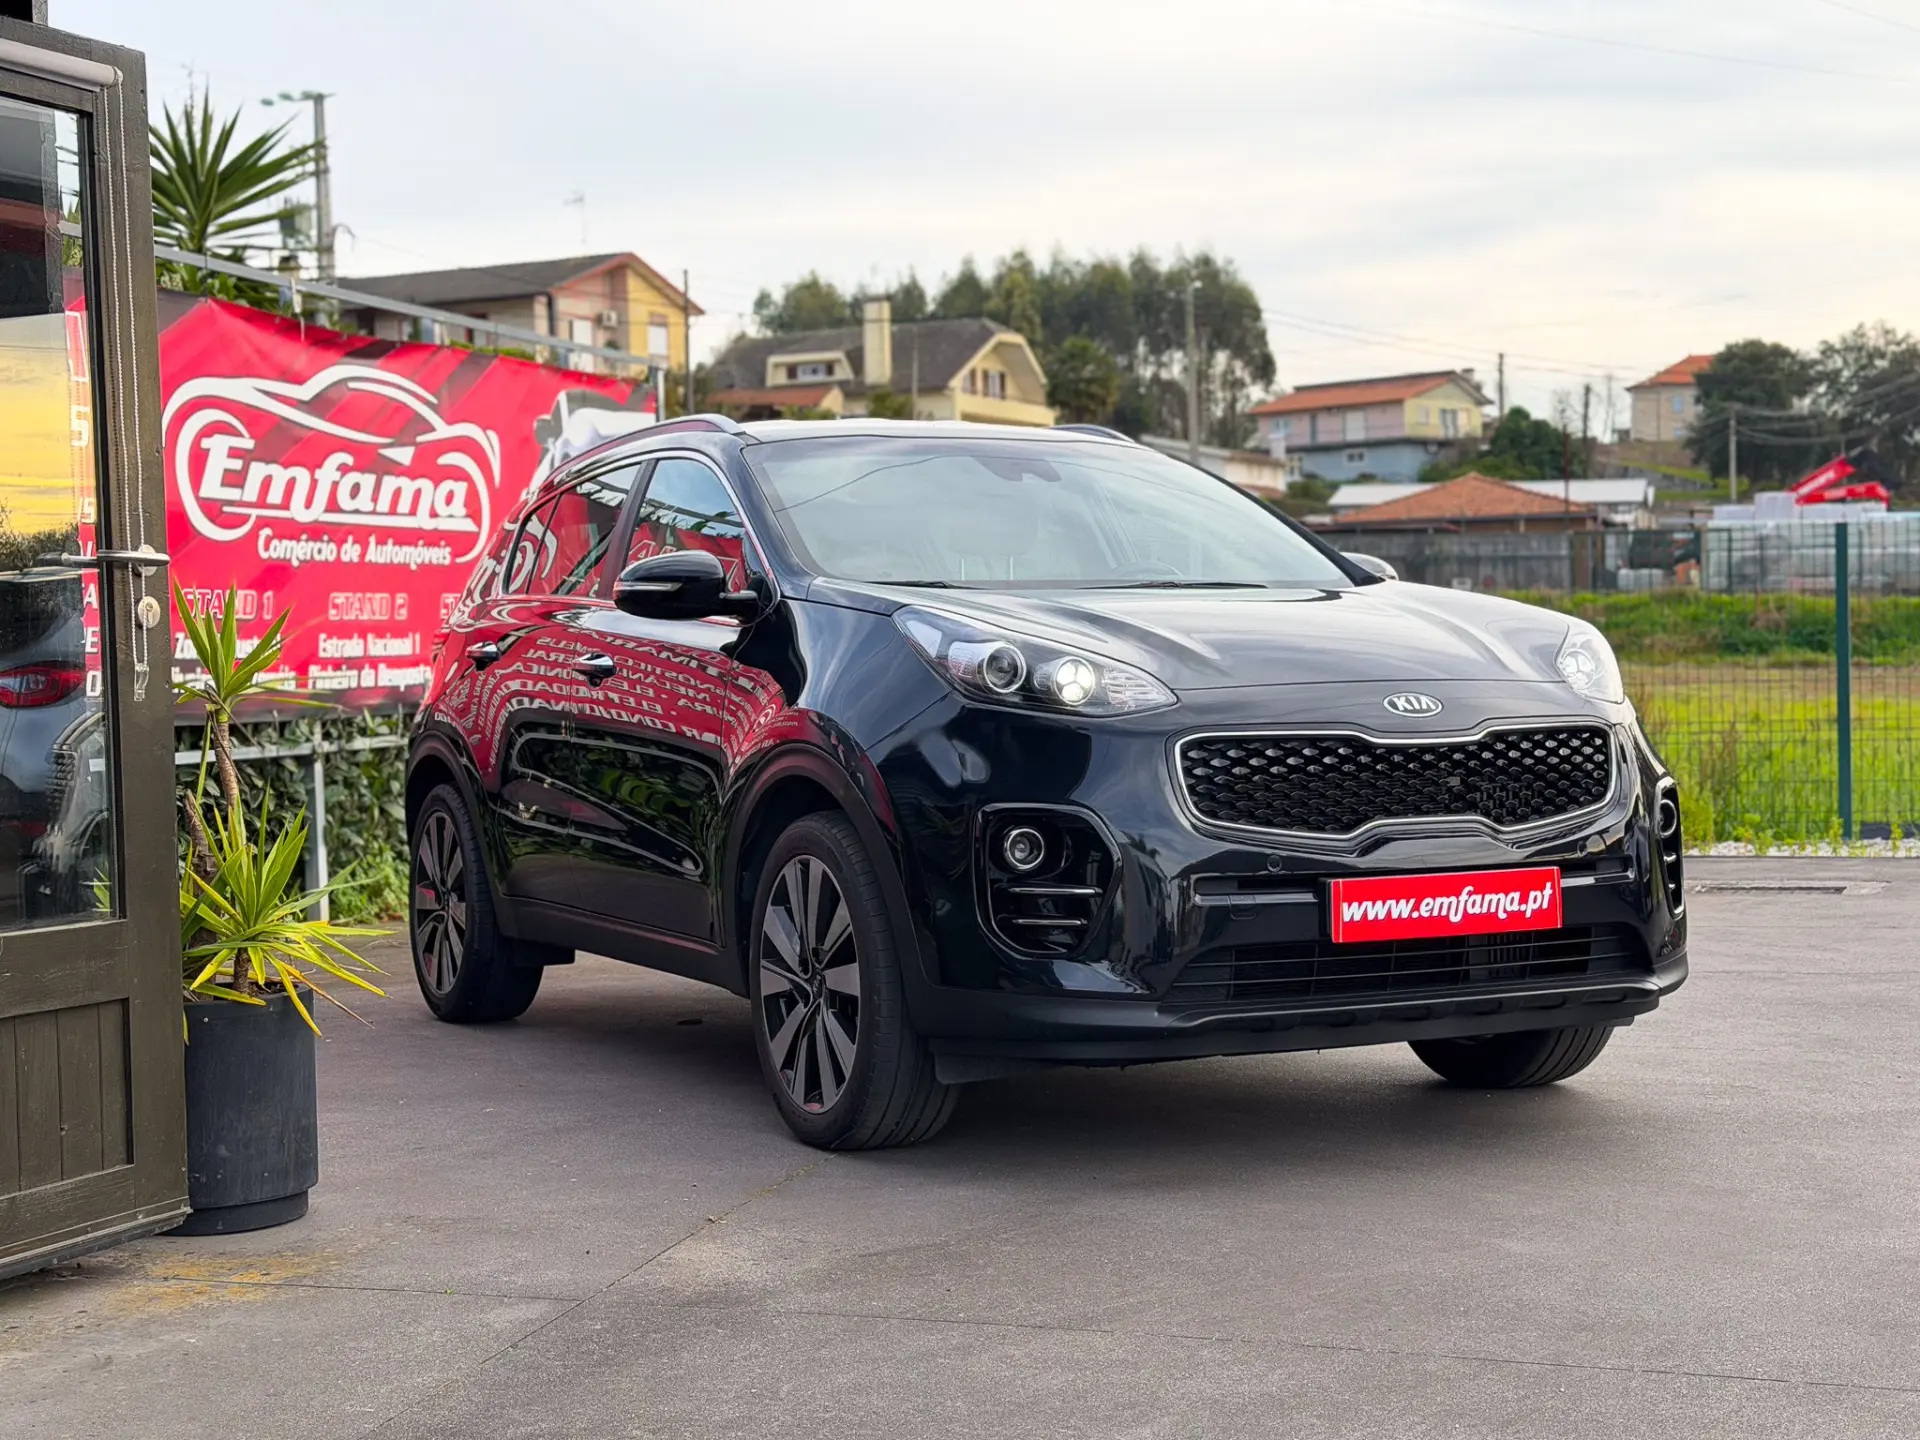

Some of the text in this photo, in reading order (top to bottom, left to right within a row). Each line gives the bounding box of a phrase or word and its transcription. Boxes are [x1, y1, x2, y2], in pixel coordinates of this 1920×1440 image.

[199, 434, 468, 531] Emfama
[257, 527, 452, 571] Comércio de Automóveis
[180, 588, 274, 620] STAD 1
[328, 591, 391, 621] STAND
[394, 592, 409, 621] 2
[1391, 695, 1437, 712] KIA
[1341, 881, 1553, 923] www.emfama.pt
